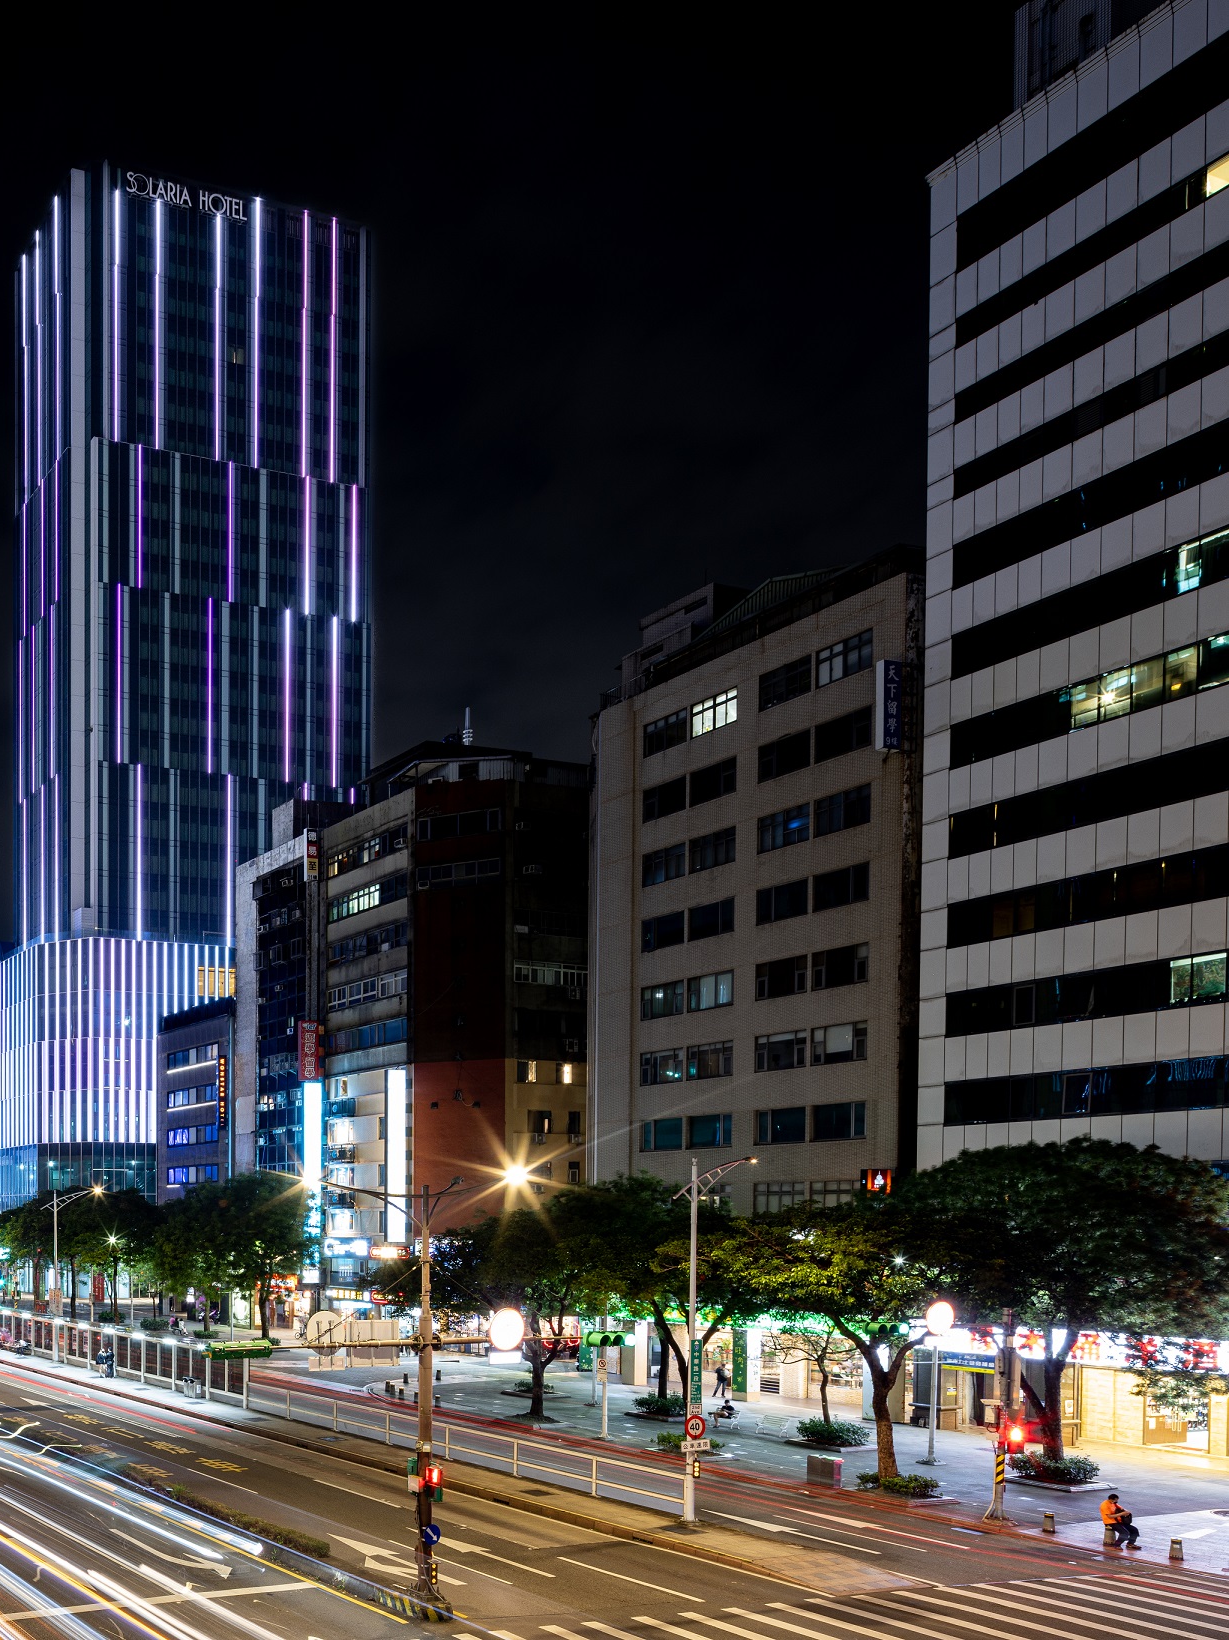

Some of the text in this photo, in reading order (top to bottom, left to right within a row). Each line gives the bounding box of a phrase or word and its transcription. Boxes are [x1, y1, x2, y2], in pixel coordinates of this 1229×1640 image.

[126, 171, 248, 220] SOLARIA HOTEL
[886, 665, 900, 733] 天下留學
[690, 1423, 700, 1431] 40
